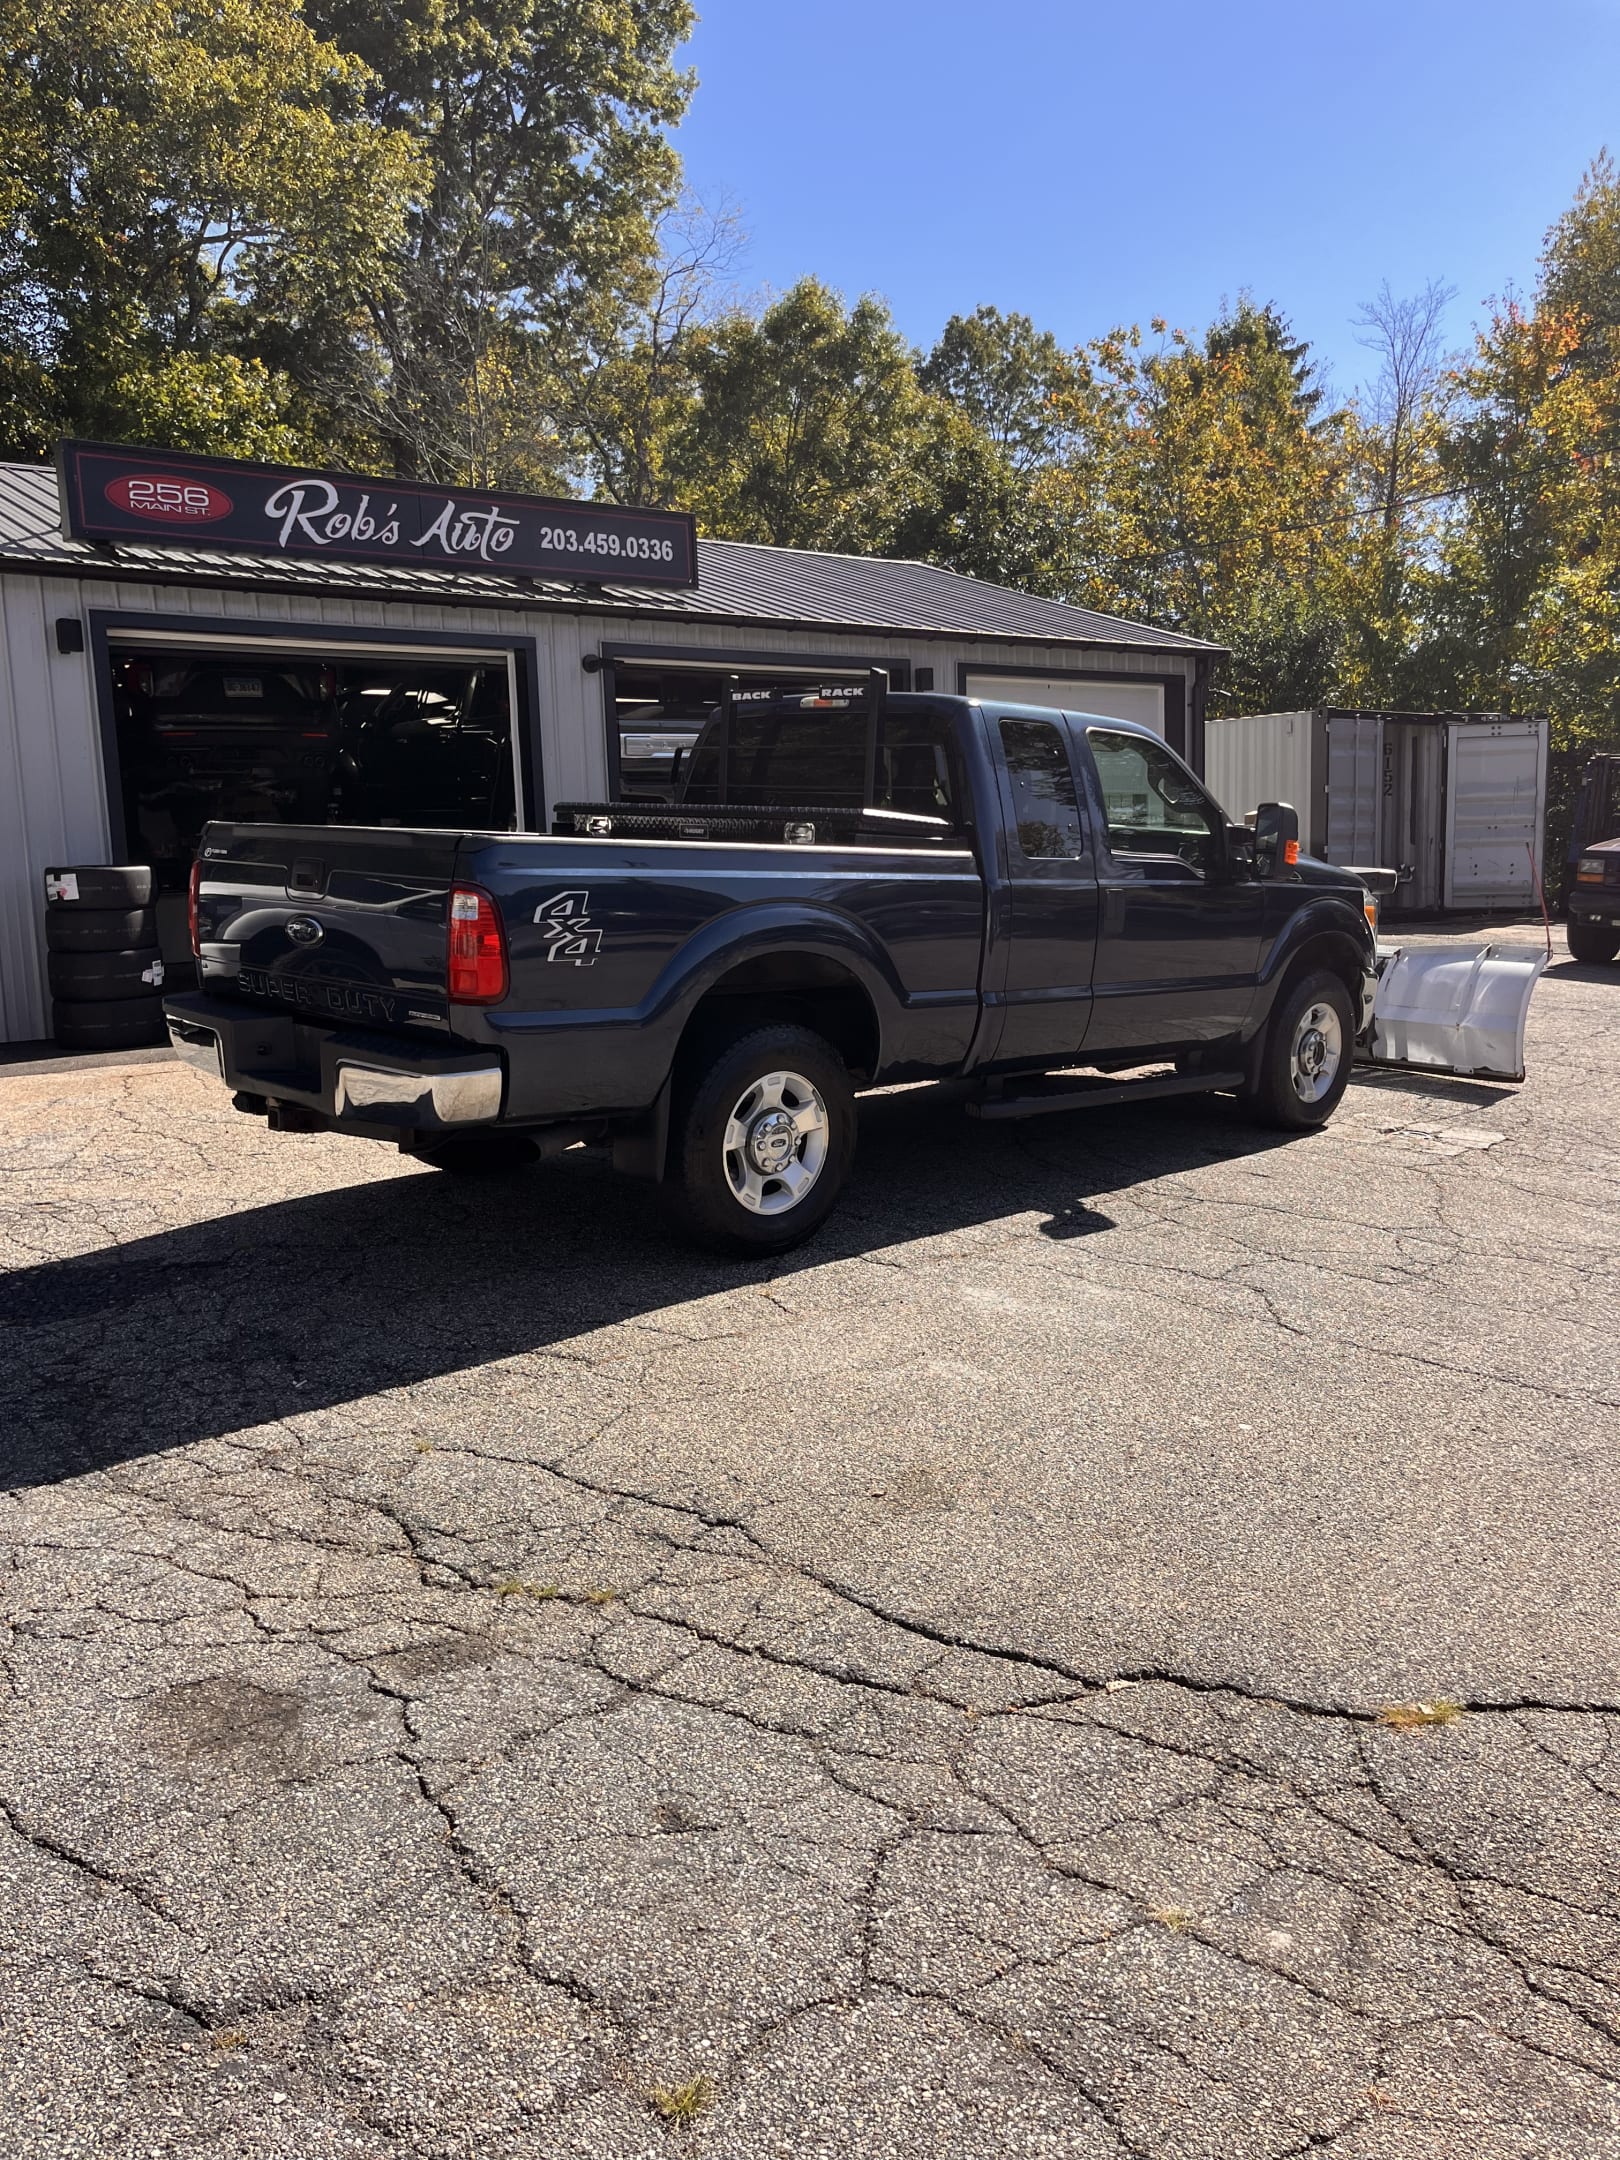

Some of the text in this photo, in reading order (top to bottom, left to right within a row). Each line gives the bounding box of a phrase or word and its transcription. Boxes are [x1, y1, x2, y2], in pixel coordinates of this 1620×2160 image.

[128, 480, 210, 507] 256
[130, 500, 211, 516] MAIN ST.
[264, 479, 521, 562] Rob's Auto
[540, 526, 674, 562] 203.459.0336
[732, 687, 864, 701] BACK RACK
[1383, 742, 1393, 798] 6152
[239, 973, 397, 1022] SUPER DUTY
